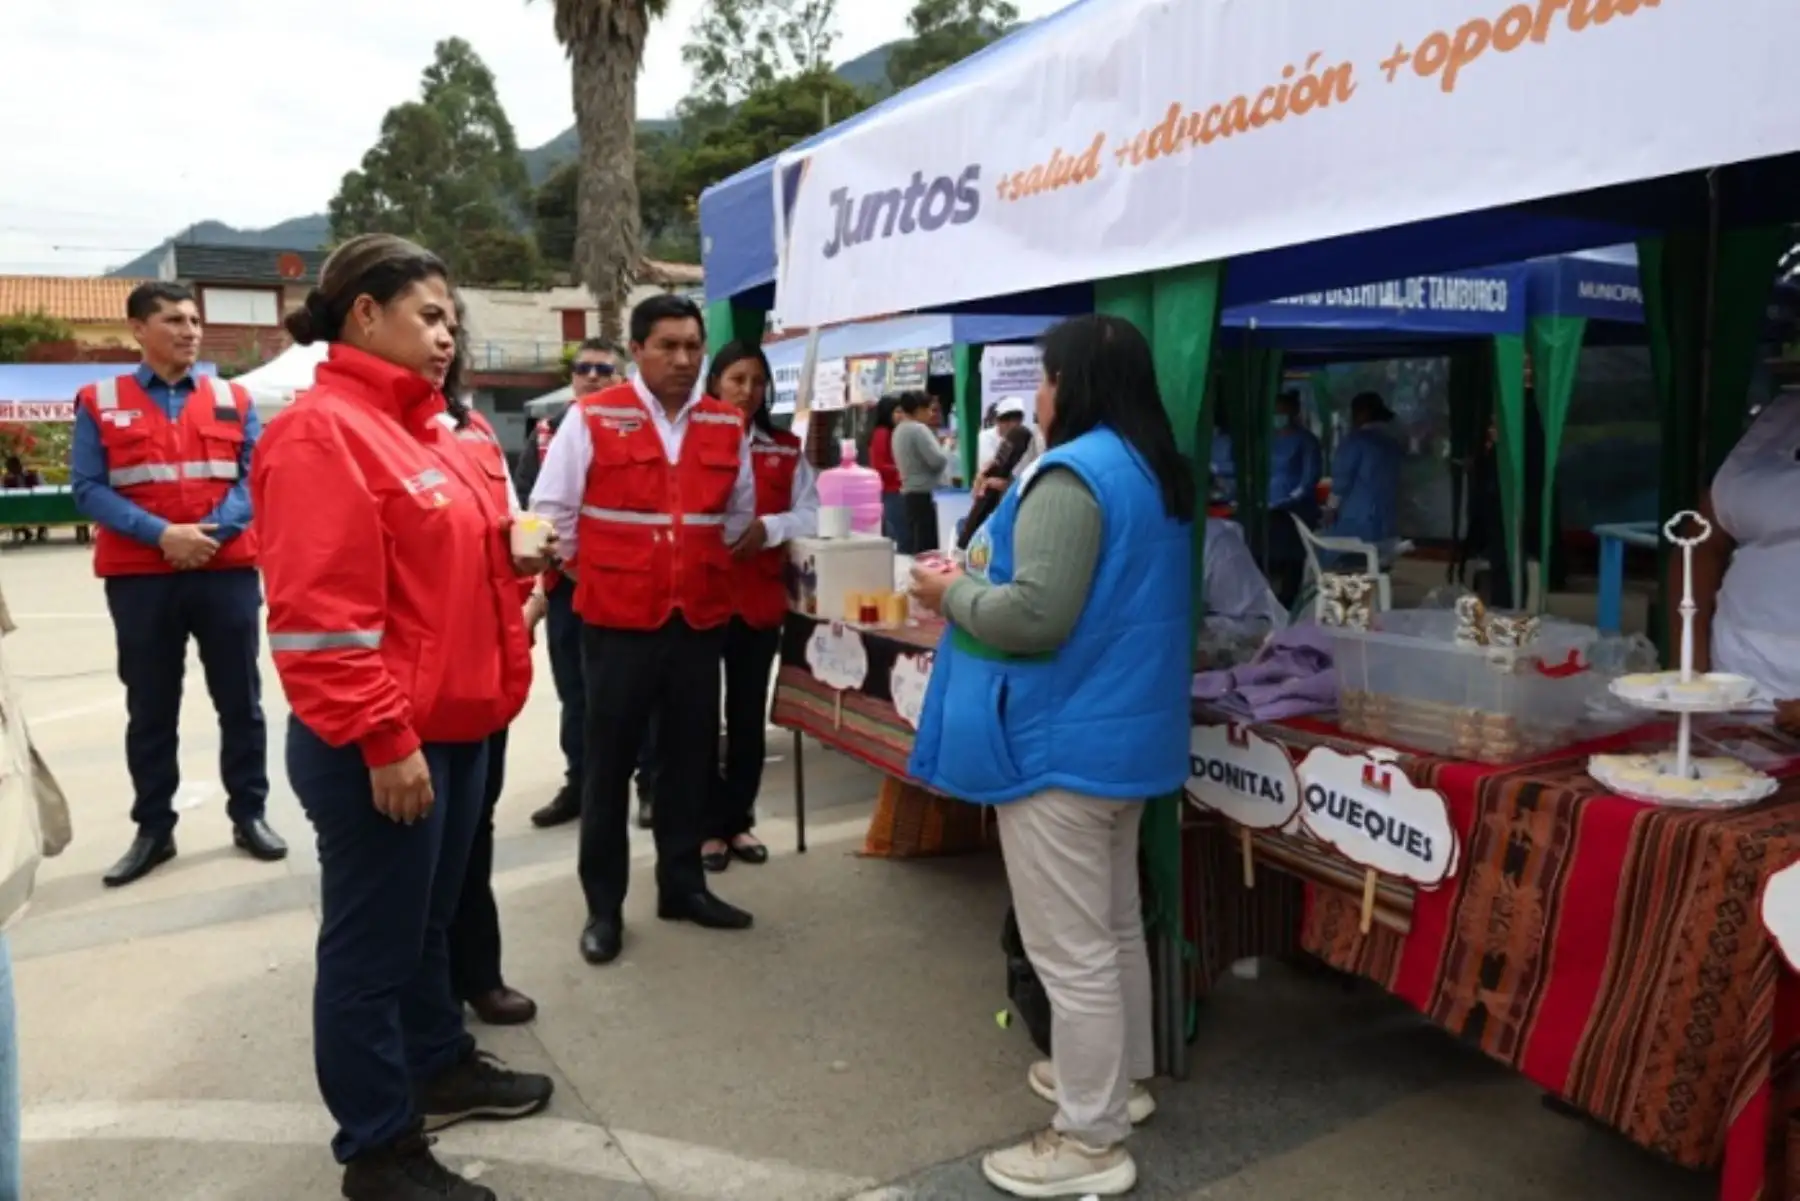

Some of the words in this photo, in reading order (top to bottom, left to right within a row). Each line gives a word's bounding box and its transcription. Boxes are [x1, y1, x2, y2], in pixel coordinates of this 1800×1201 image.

[823, 164, 981, 259] Juntos
[996, 132, 1105, 202] +salud
[1114, 50, 1358, 167] +educación
[1428, 276, 1508, 312] TAMBURCO
[1190, 756, 1284, 804] DONITAS
[1304, 783, 1433, 862] QUEQUES
